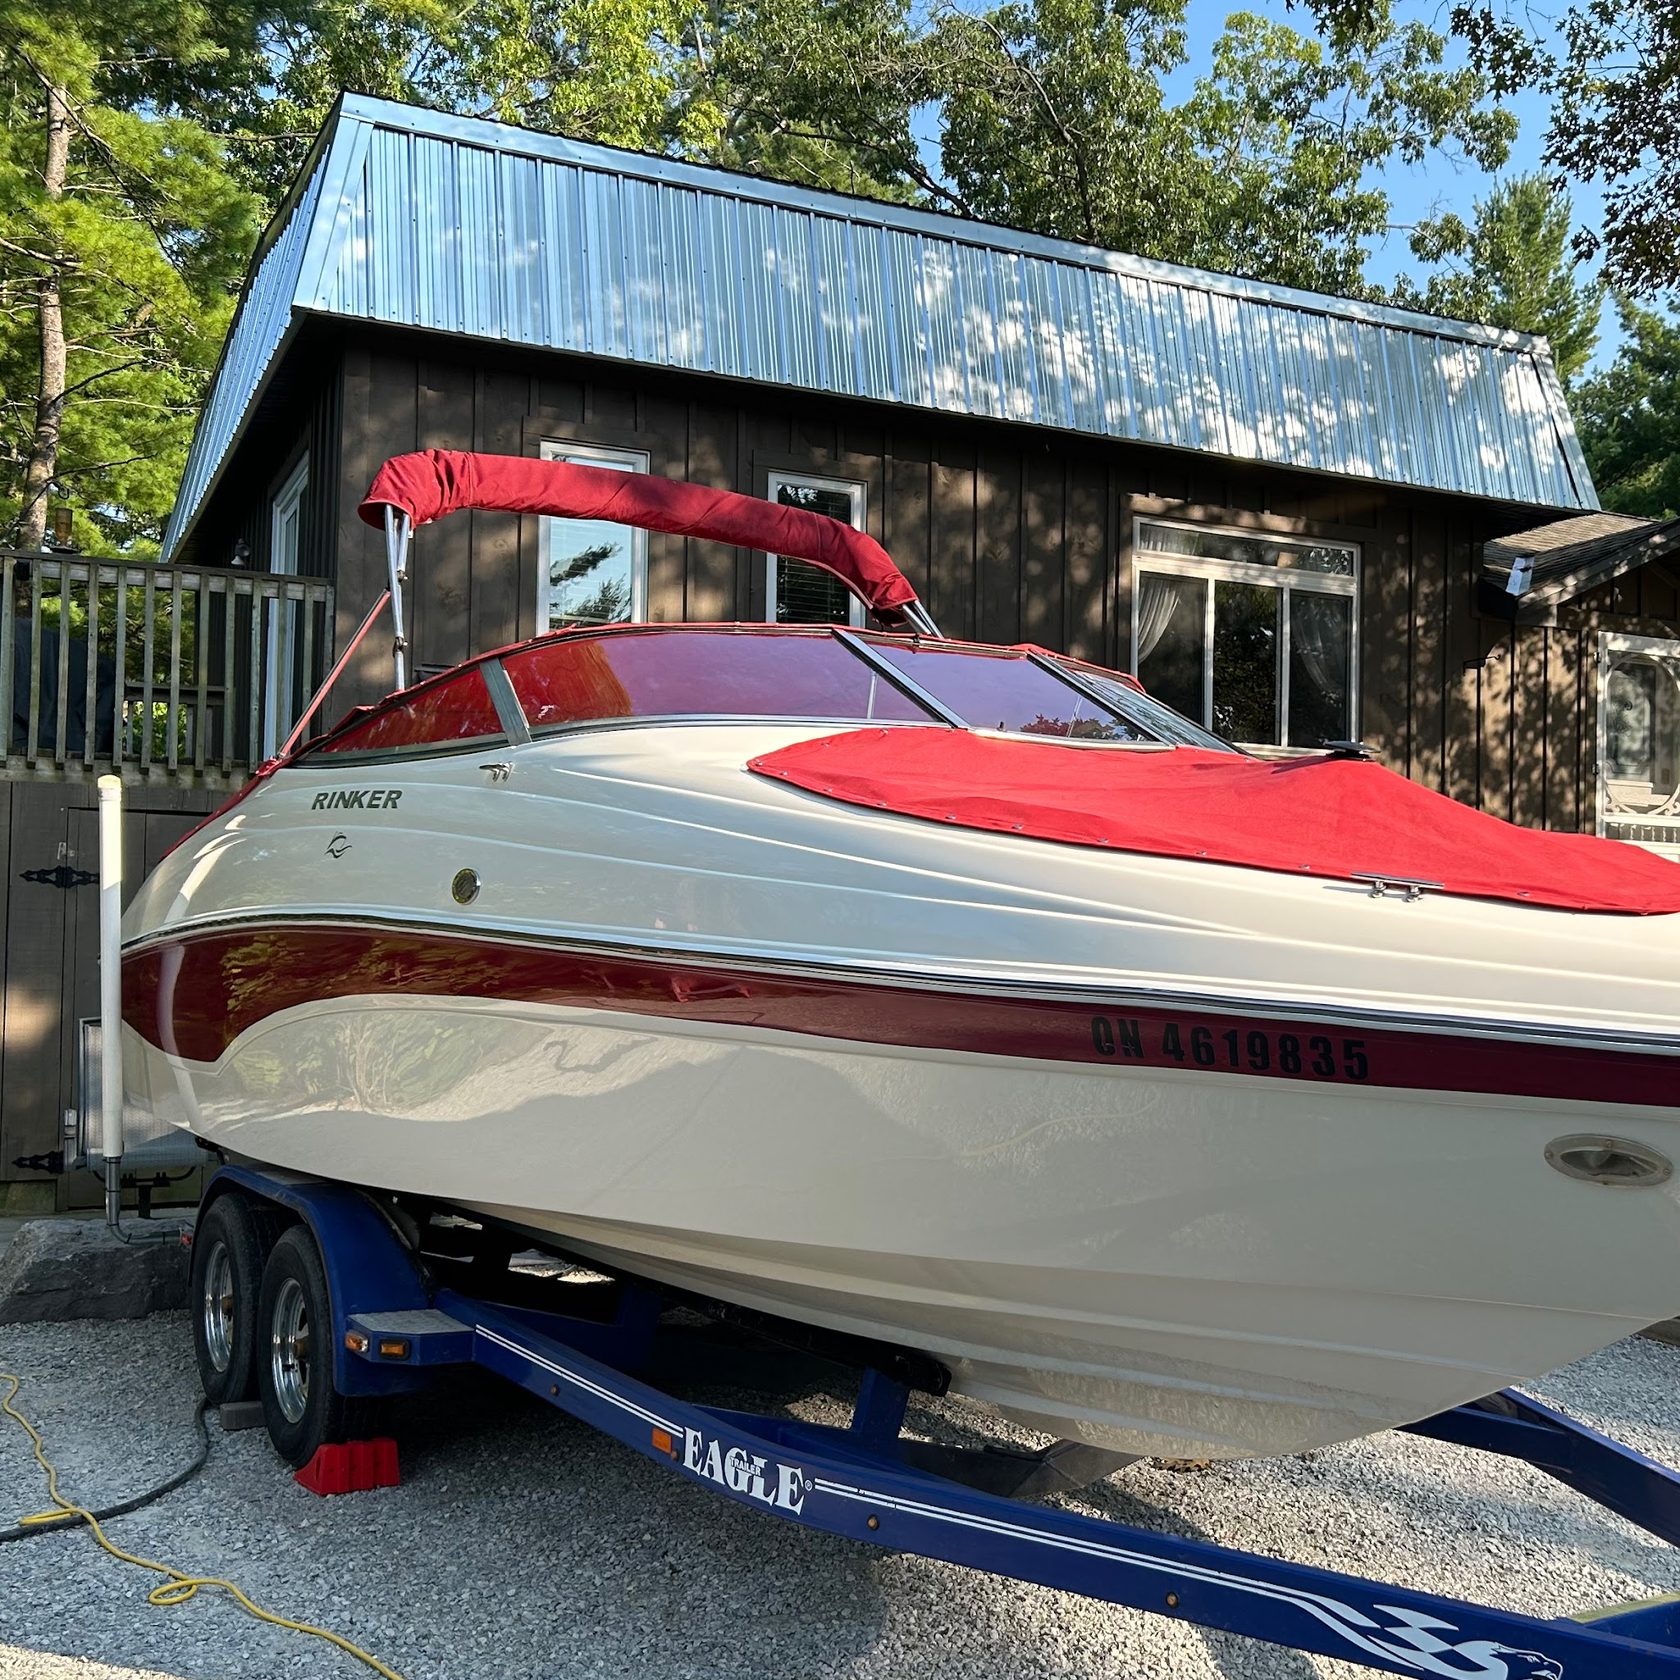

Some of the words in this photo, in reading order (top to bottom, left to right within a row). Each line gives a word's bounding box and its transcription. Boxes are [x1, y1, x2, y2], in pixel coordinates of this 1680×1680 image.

[311, 790, 402, 810] RINKER
[1163, 1023, 1369, 1080] 4619835
[729, 1456, 761, 1477] TRAILER
